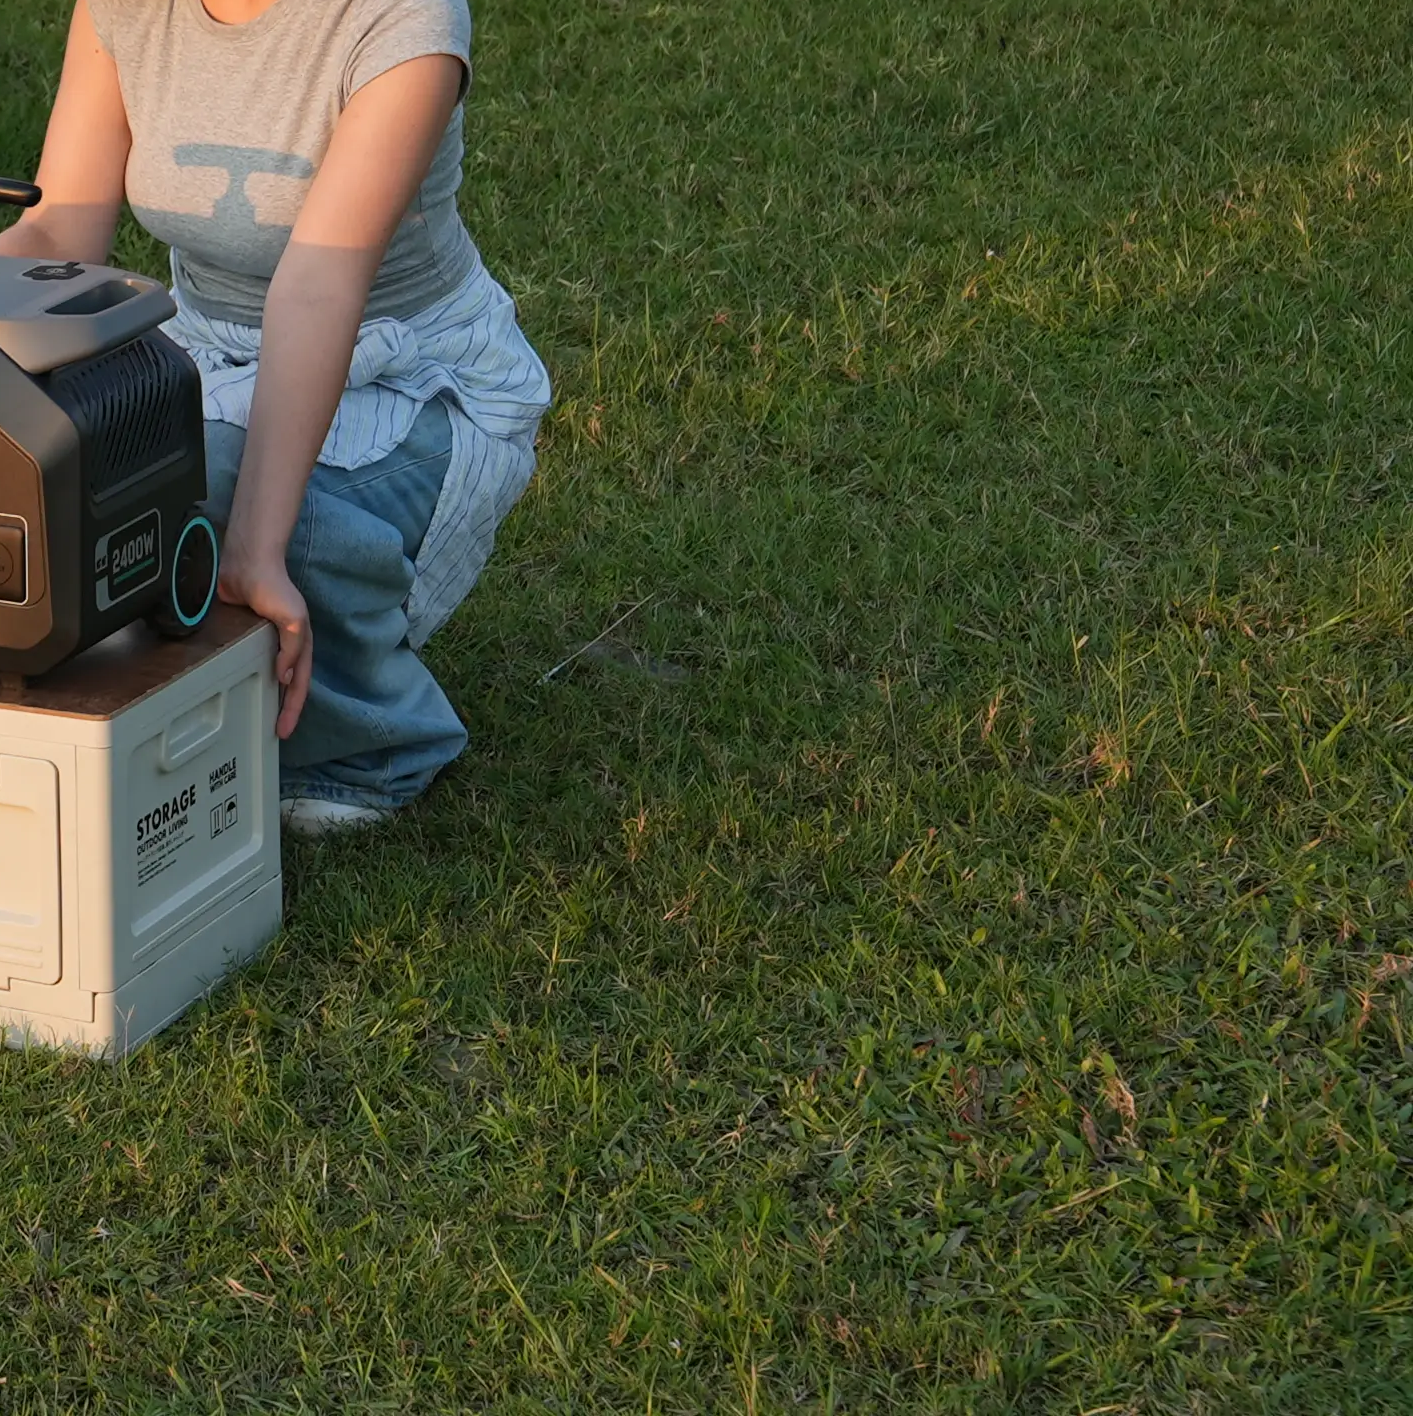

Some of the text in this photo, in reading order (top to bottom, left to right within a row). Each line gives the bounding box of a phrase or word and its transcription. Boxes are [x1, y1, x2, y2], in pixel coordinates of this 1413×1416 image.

[113, 528, 154, 575] 2400W
[209, 756, 237, 785] HANDLE
[209, 769, 237, 793] WITH CARE
[137, 784, 196, 841] STORAGE
[137, 829, 166, 855] OUTDOOR
[168, 814, 188, 835] LIVING
